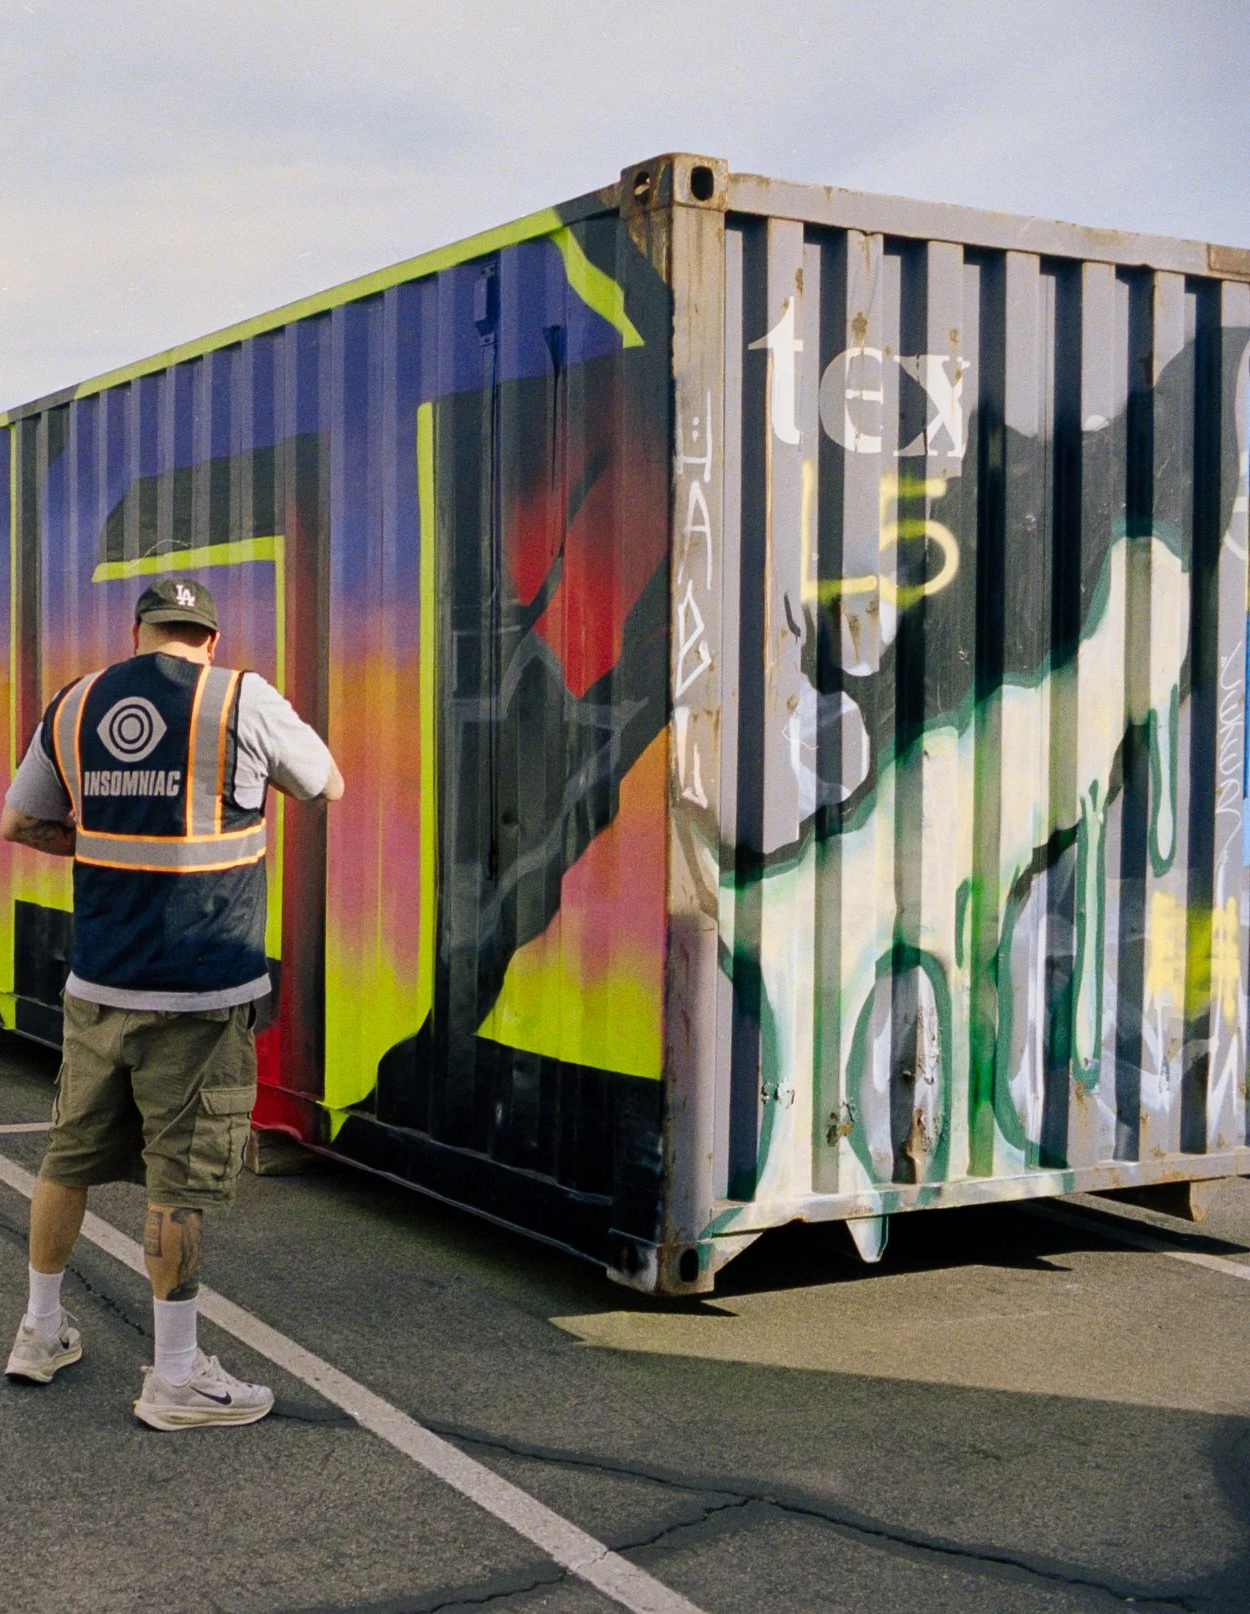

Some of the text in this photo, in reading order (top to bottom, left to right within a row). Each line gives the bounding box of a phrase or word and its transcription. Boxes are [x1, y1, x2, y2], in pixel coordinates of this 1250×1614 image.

[748, 296, 970, 457] tex
[176, 584, 196, 607] LA
[84, 770, 181, 797] INSOMNIAC
